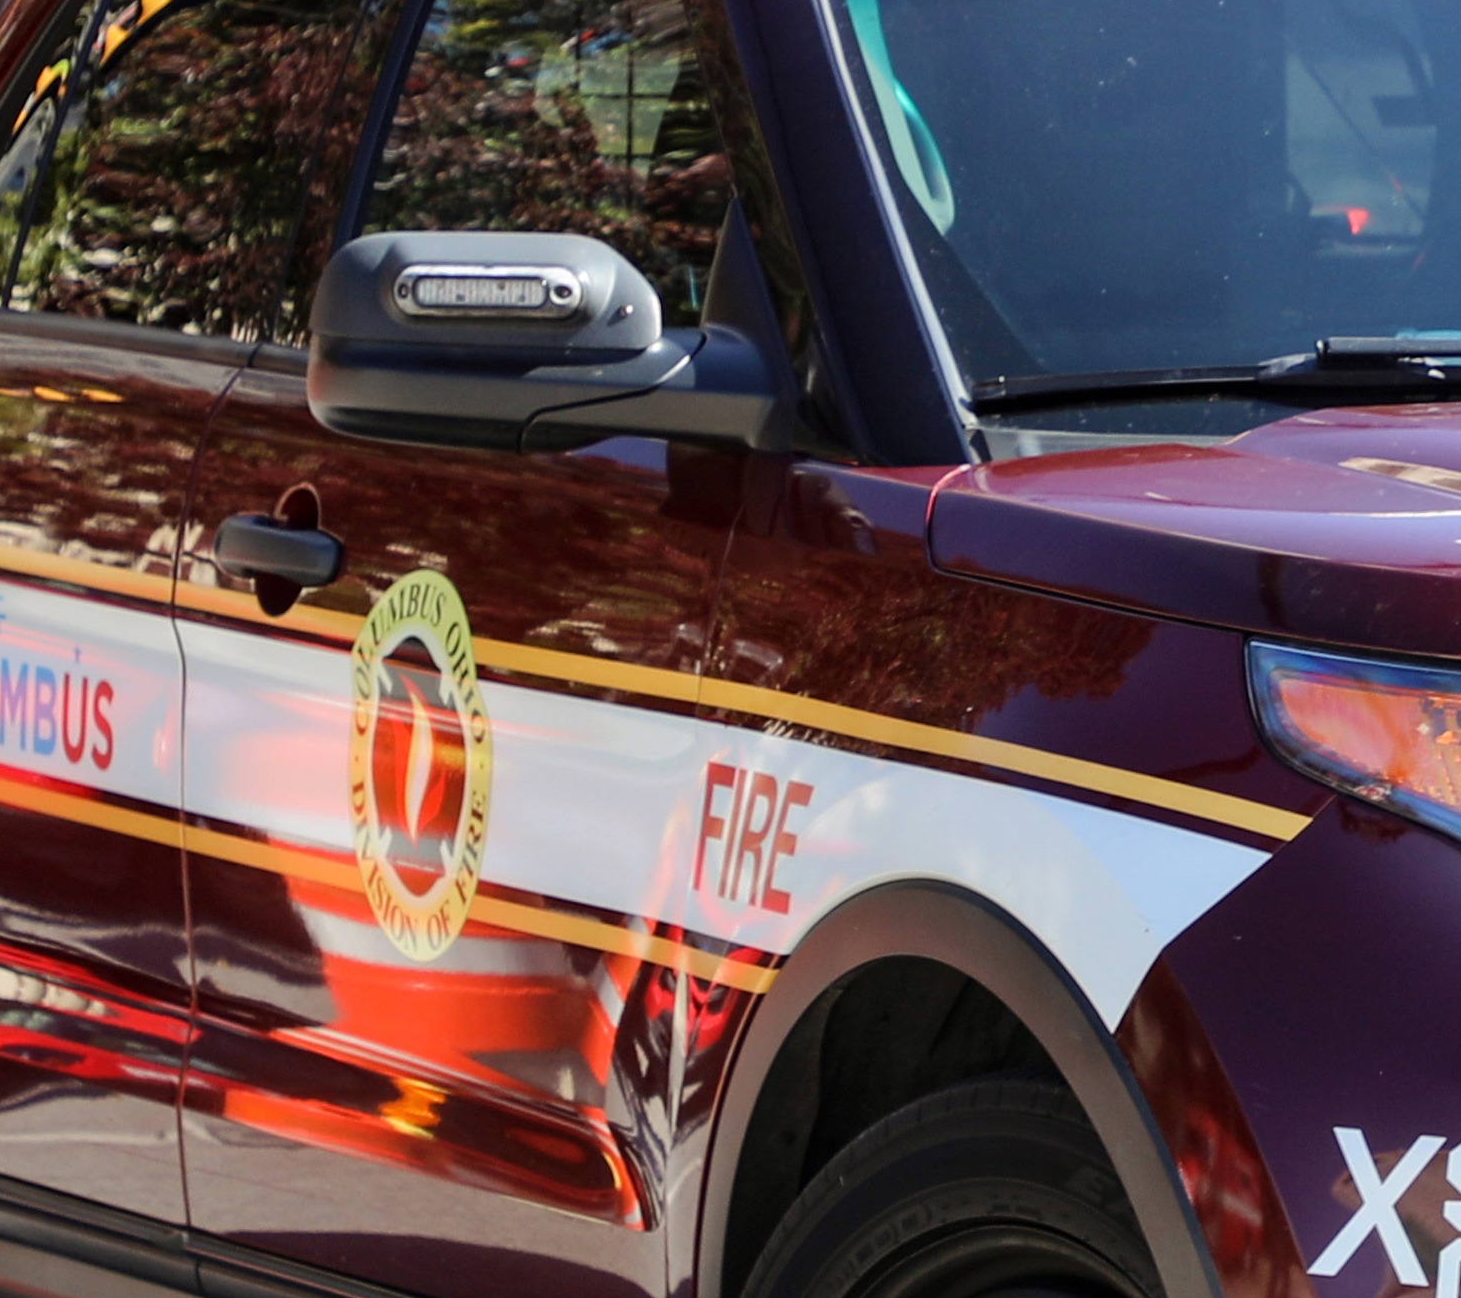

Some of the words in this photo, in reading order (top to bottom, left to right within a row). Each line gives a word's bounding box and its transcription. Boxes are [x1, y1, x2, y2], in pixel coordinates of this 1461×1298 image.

[354, 583, 446, 736] COLUMBUS
[446, 621, 486, 744] OHIO
[352, 780, 417, 951] DIVISION
[426, 898, 452, 950] OF
[455, 789, 487, 905] FIRE
[693, 761, 815, 915] FIRE
